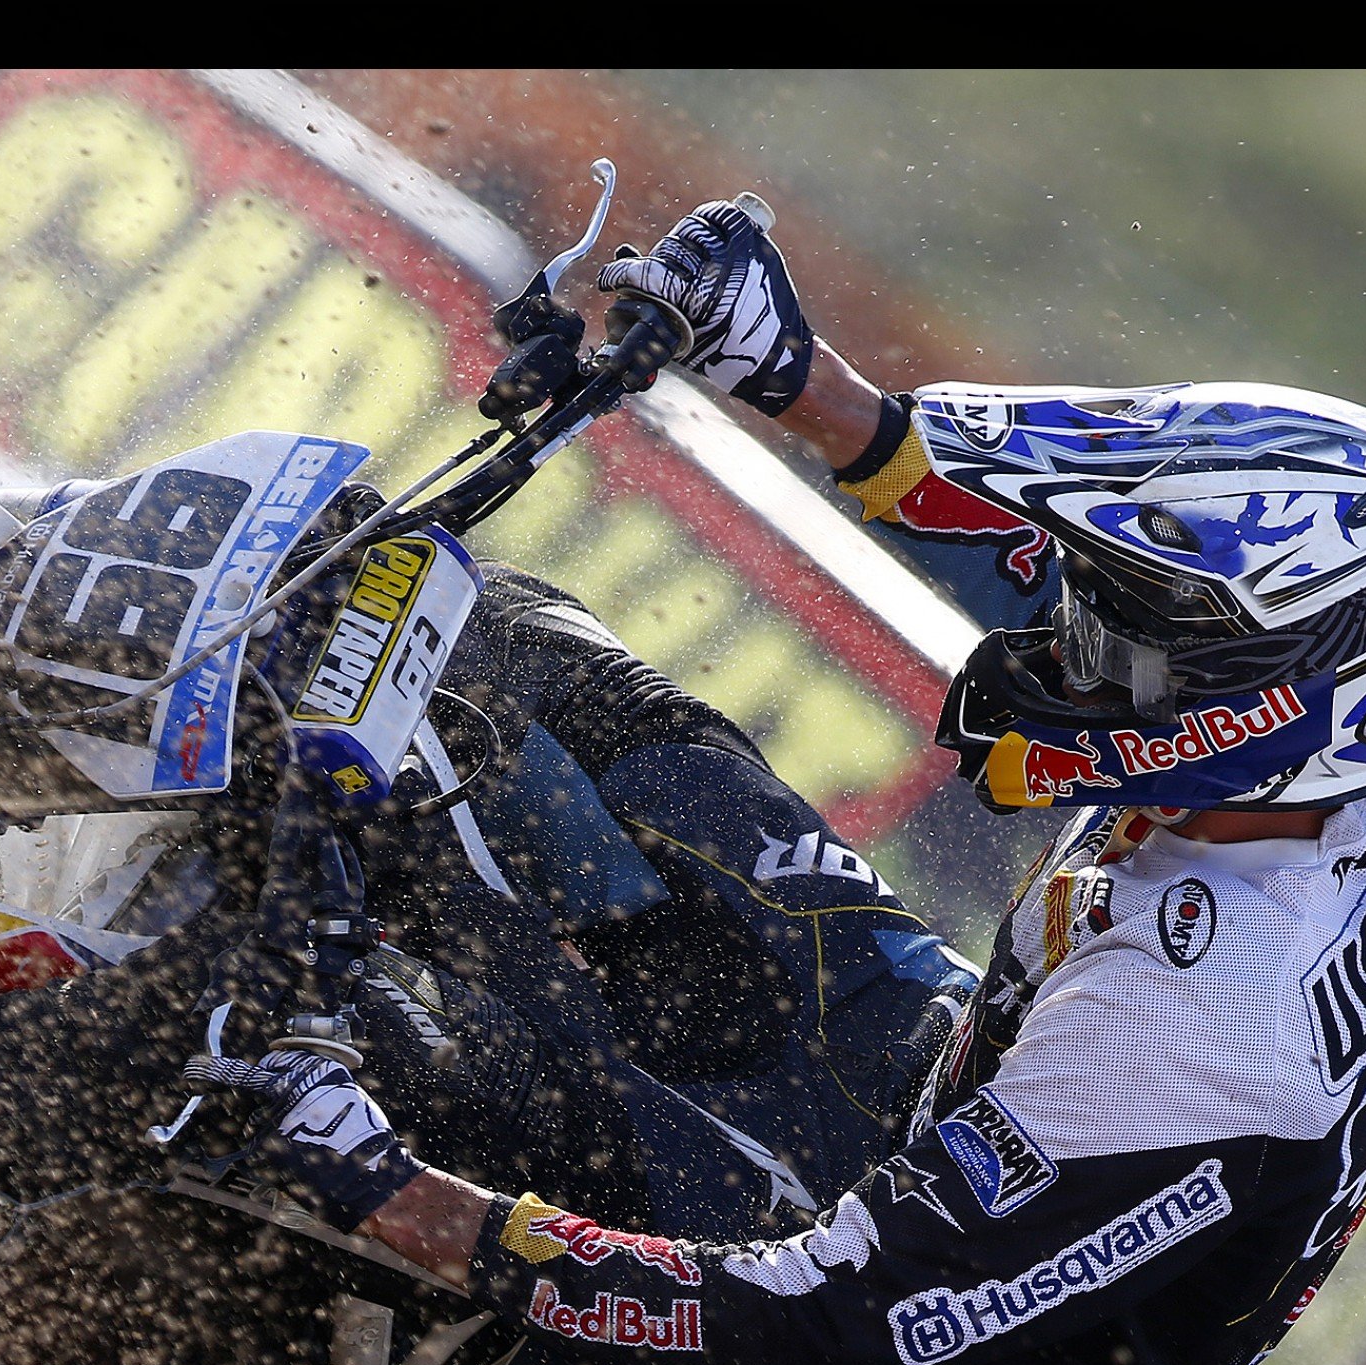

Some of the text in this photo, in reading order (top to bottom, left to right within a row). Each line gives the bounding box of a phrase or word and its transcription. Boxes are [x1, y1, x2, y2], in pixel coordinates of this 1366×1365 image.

[1109, 684, 1308, 775] Red Bull
[962, 1175, 1221, 1339] Husqvarna
[527, 1278, 703, 1351] Red Bull
